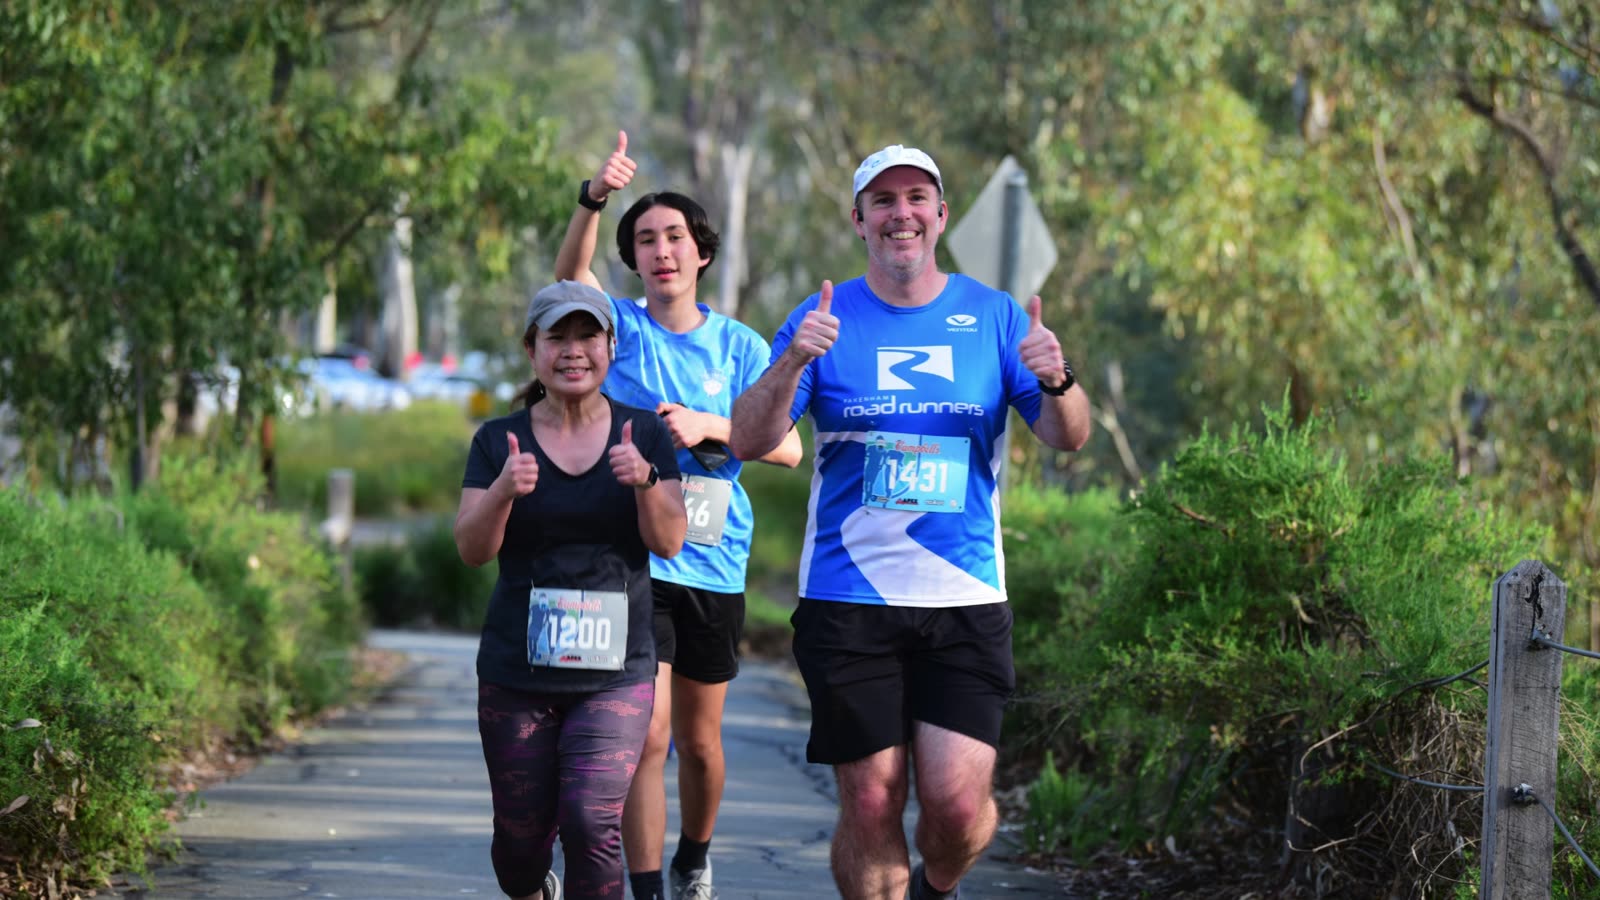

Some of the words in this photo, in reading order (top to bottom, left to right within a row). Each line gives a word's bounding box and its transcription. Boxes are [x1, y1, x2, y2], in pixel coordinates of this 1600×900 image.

[843, 395, 896, 418] road
[899, 401, 984, 416] runners
[888, 459, 949, 493] 1431
[549, 614, 611, 650] 1200
